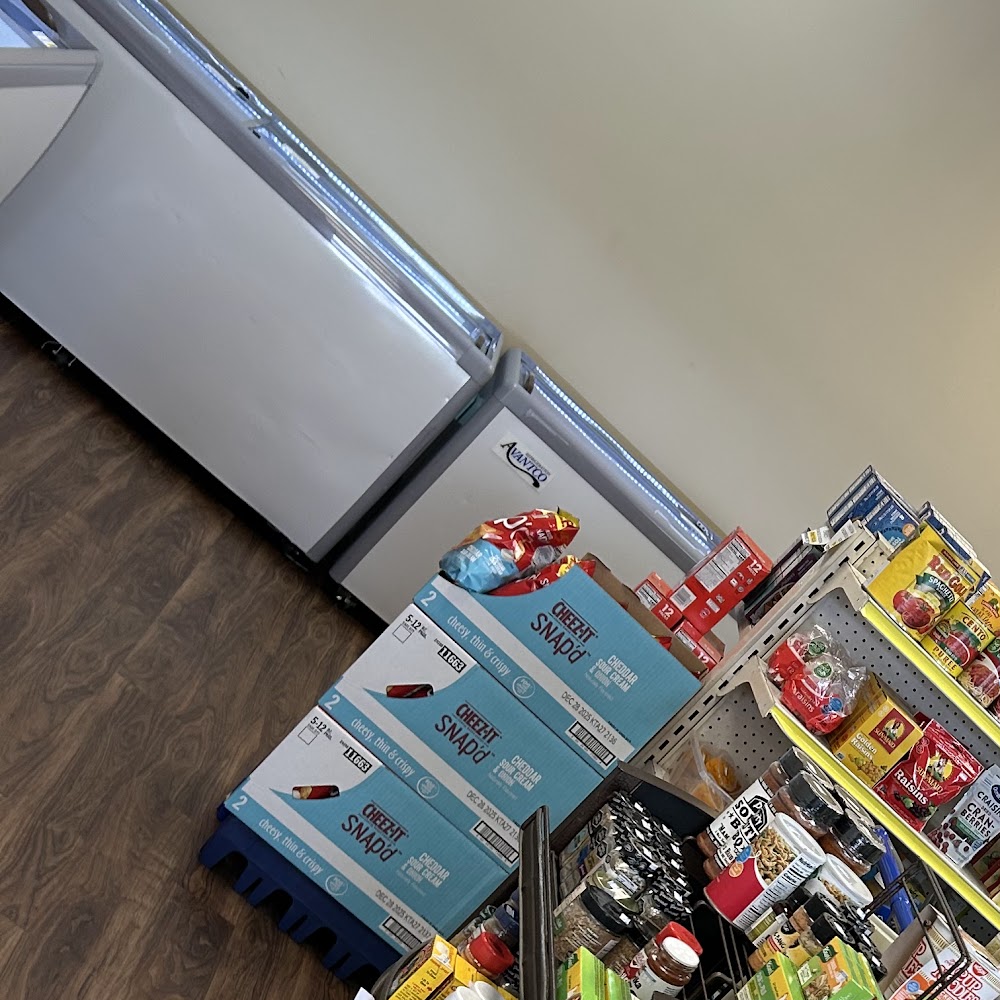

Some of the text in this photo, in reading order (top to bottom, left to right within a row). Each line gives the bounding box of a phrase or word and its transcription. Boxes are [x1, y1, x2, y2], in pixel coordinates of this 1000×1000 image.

[749, 558, 763, 574] 12
[419, 588, 437, 607] 2
[659, 602, 675, 619] 12
[961, 615, 987, 641] CENTO
[437, 646, 466, 672] 11663
[444, 613, 473, 641] cheesy,
[468, 632, 488, 652] thin
[487, 653, 512, 678] crispy
[932, 646, 957, 670] PUREE
[594, 658, 631, 692] SOUR CREAM
[606, 653, 639, 685] CHEDDAR
[323, 692, 342, 711] 2
[559, 690, 592, 721] DEC 2025
[349, 716, 377, 743] cheesy,
[373, 735, 392, 754] thin
[391, 755, 416, 779] crispy
[849, 737, 874, 760] Raisins
[854, 732, 878, 754] Golden
[343, 747, 371, 772] 11663
[498, 757, 534, 792] SOUR CREAM
[510, 754, 542, 784] CHEDDAR
[892, 768, 931, 805] Raisins
[231, 793, 249, 811] 2
[465, 789, 498, 820] DEC 2025
[966, 801, 995, 831] CRAN-
[960, 808, 990, 838] BERRIES
[257, 816, 323, 877] cheesy, thin crispy
[406, 855, 424, 872] SOUR
[420, 868, 442, 887] CREAM
[418, 851, 450, 881] CHEDDAR
[391, 904, 406, 918] 2025
